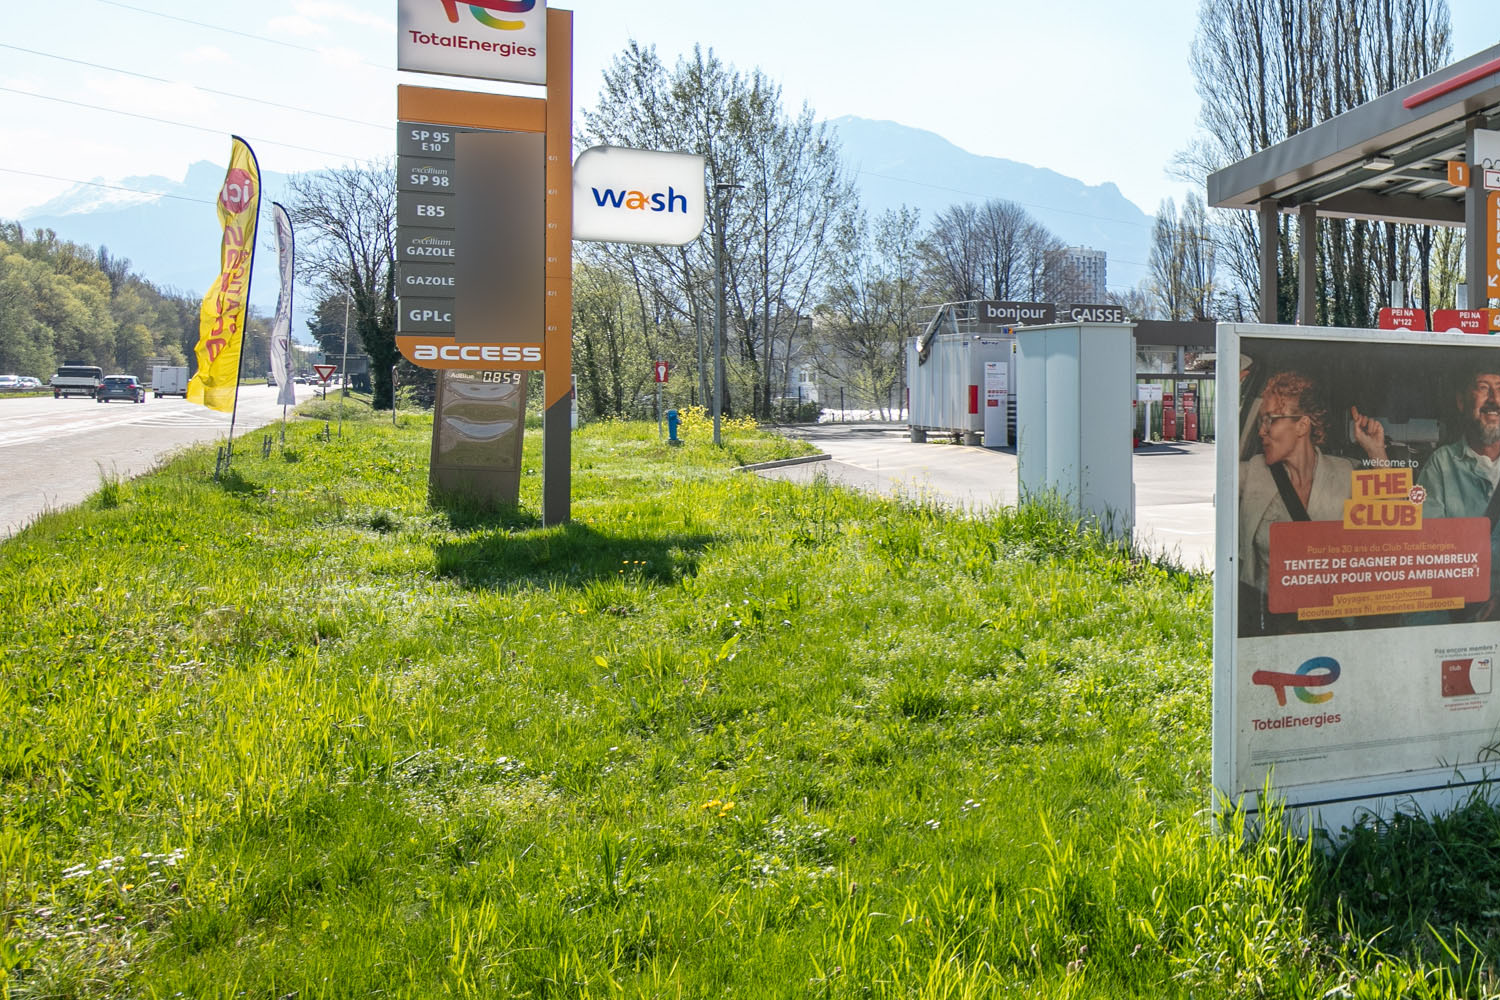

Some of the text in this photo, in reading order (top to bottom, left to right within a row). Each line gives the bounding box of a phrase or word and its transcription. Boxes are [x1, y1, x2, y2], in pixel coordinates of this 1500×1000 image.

[408, 30, 536, 57] TotalEnergies
[411, 130, 450, 143] SP 95
[411, 166, 448, 176] excellium
[1456, 166, 1464, 181] 1
[410, 174, 449, 187] SP 98
[592, 186, 688, 214] wash
[416, 204, 446, 218] E85
[412, 238, 452, 247] excellium
[406, 246, 456, 258] GAZOLE
[406, 275, 456, 286] GAZOLE
[409, 309, 452, 322] GPLc
[987, 304, 1047, 321] bonjour
[1071, 307, 1122, 322] CAISSE
[1391, 309, 1414, 317] PEI NA
[1459, 311, 1481, 319] PEI NA
[1362, 458, 1419, 468] welcome to
[1356, 472, 1408, 496] THE
[1350, 503, 1417, 527] CLUB
[1307, 545, 1325, 554] Pour
[1342, 544, 1353, 553] 30
[1369, 543, 1381, 552] du
[1382, 543, 1401, 552] Club
[1284, 553, 1479, 571] TENTEZ DE GAGNER DE NOMBREUX
[1281, 573, 1339, 587] CADEAUX
[1341, 571, 1372, 583] POUR
[1374, 570, 1406, 582] VOUS
[1252, 712, 1341, 732] TotalEnergies
